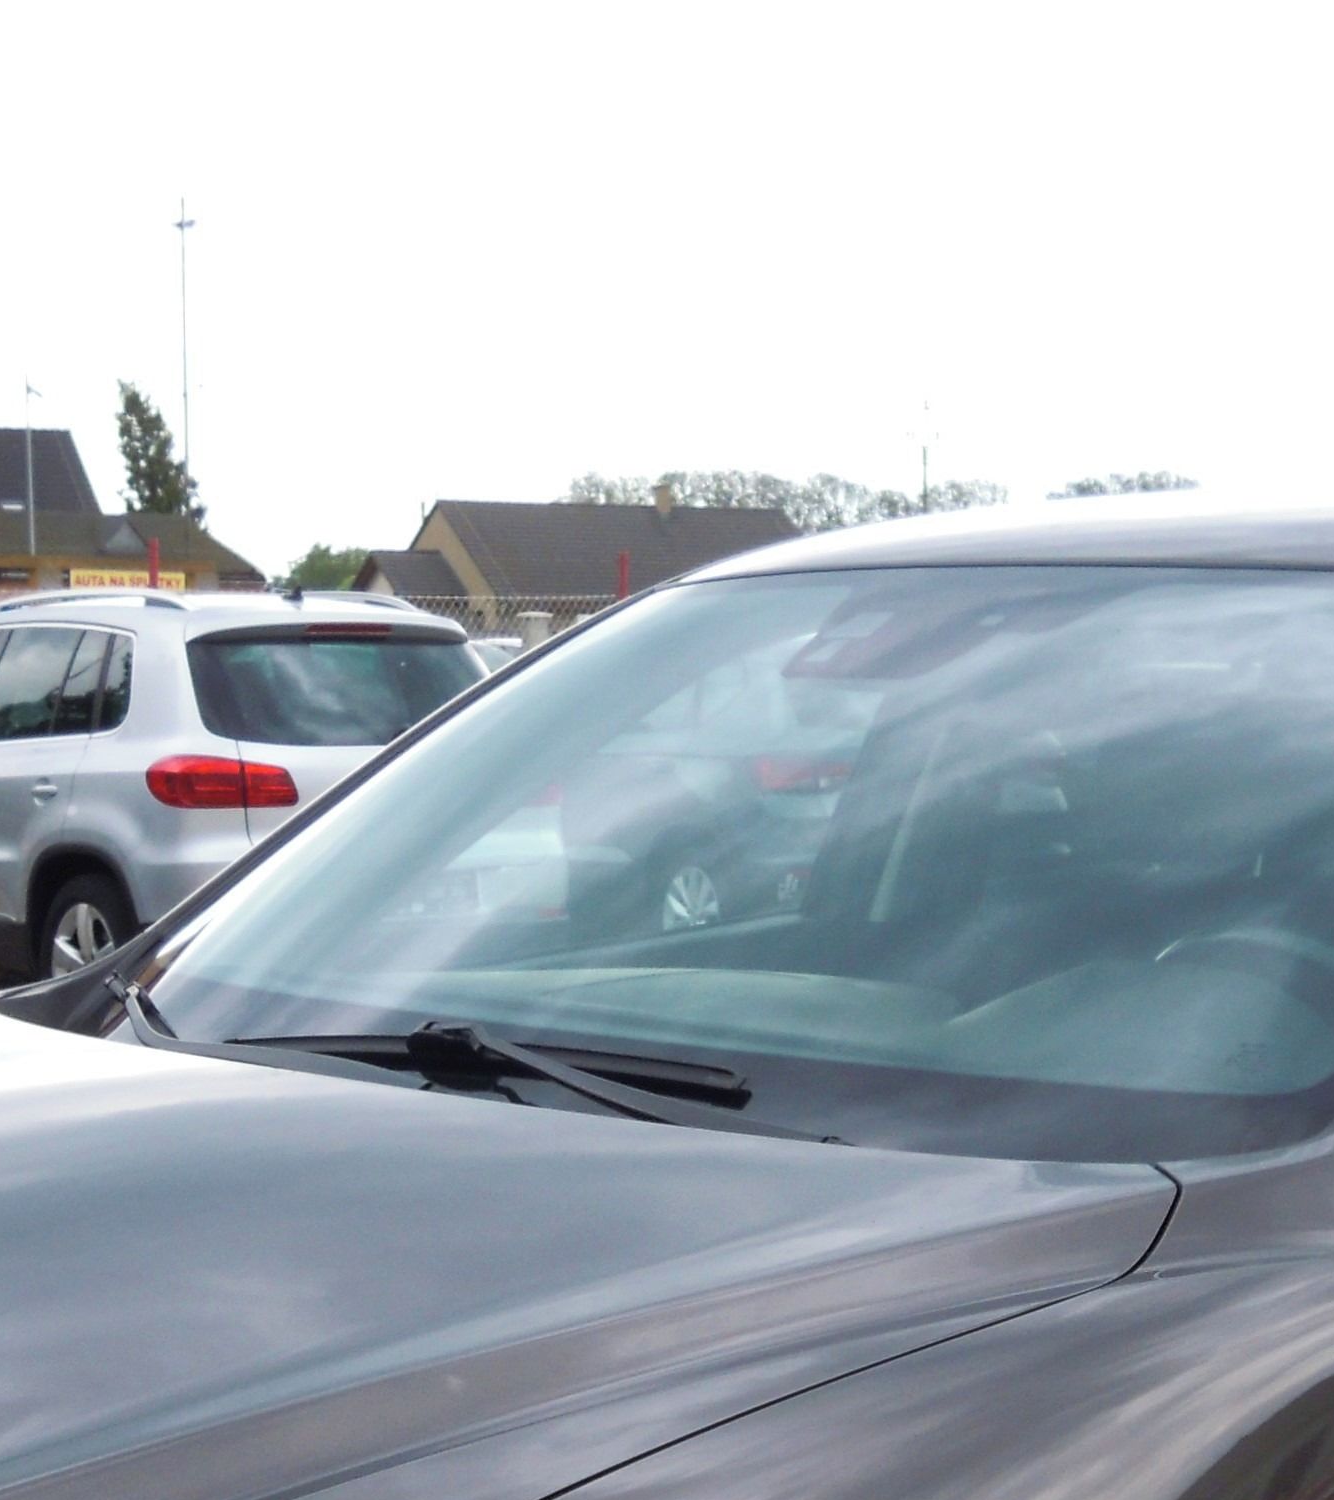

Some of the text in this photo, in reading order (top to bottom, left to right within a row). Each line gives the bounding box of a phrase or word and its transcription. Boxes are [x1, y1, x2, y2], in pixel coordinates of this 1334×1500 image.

[74, 574, 181, 589] AUTA NA SPLTKY
